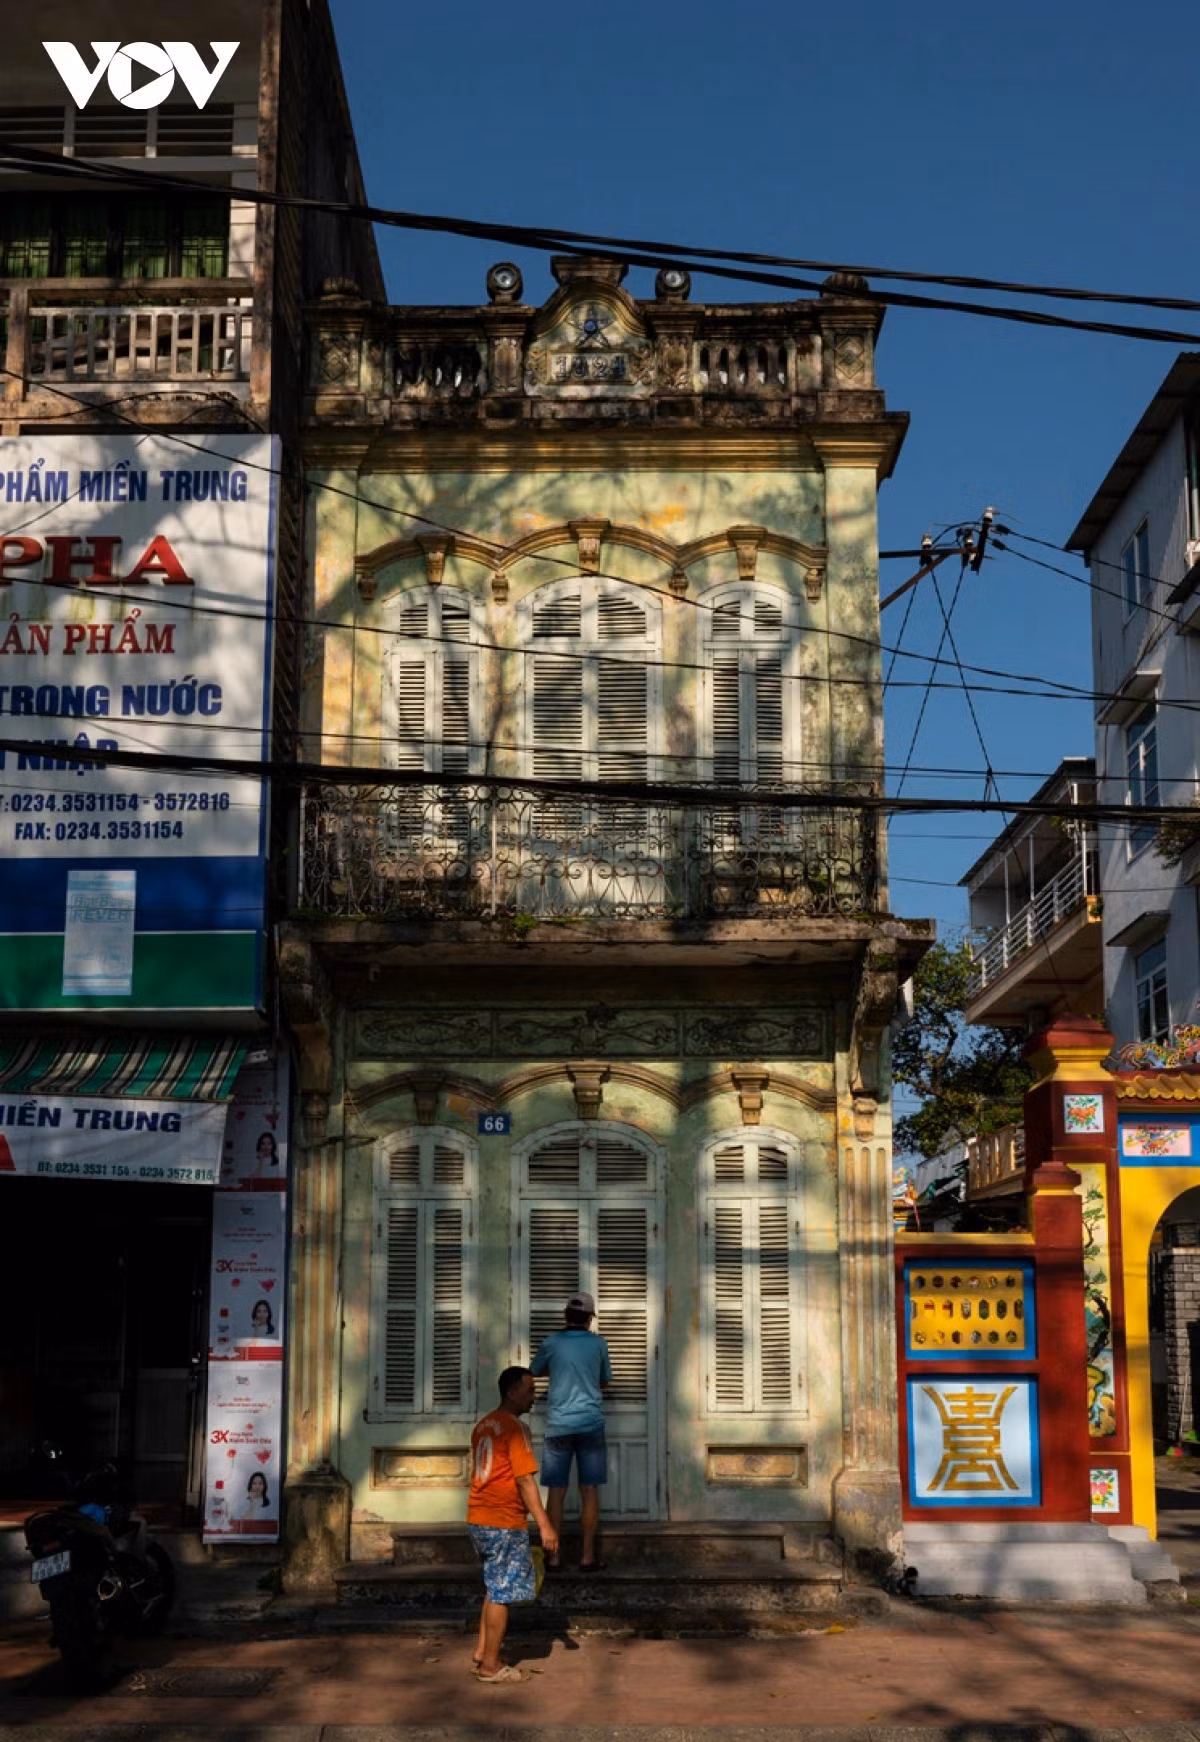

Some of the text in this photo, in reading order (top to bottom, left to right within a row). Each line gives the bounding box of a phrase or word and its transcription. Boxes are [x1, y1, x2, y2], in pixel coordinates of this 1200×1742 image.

[79, 460, 148, 502] MIỀN
[160, 470, 248, 502] TRUNG
[0, 534, 195, 586] PHA
[63, 608, 176, 656] PHẨM
[122, 674, 222, 717] NƯỚC
[154, 792, 230, 811] 3572816
[15, 821, 183, 841] FAX: 0234.3531154
[73, 1107, 182, 1132] TRUNG
[484, 1116, 504, 1131] 66
